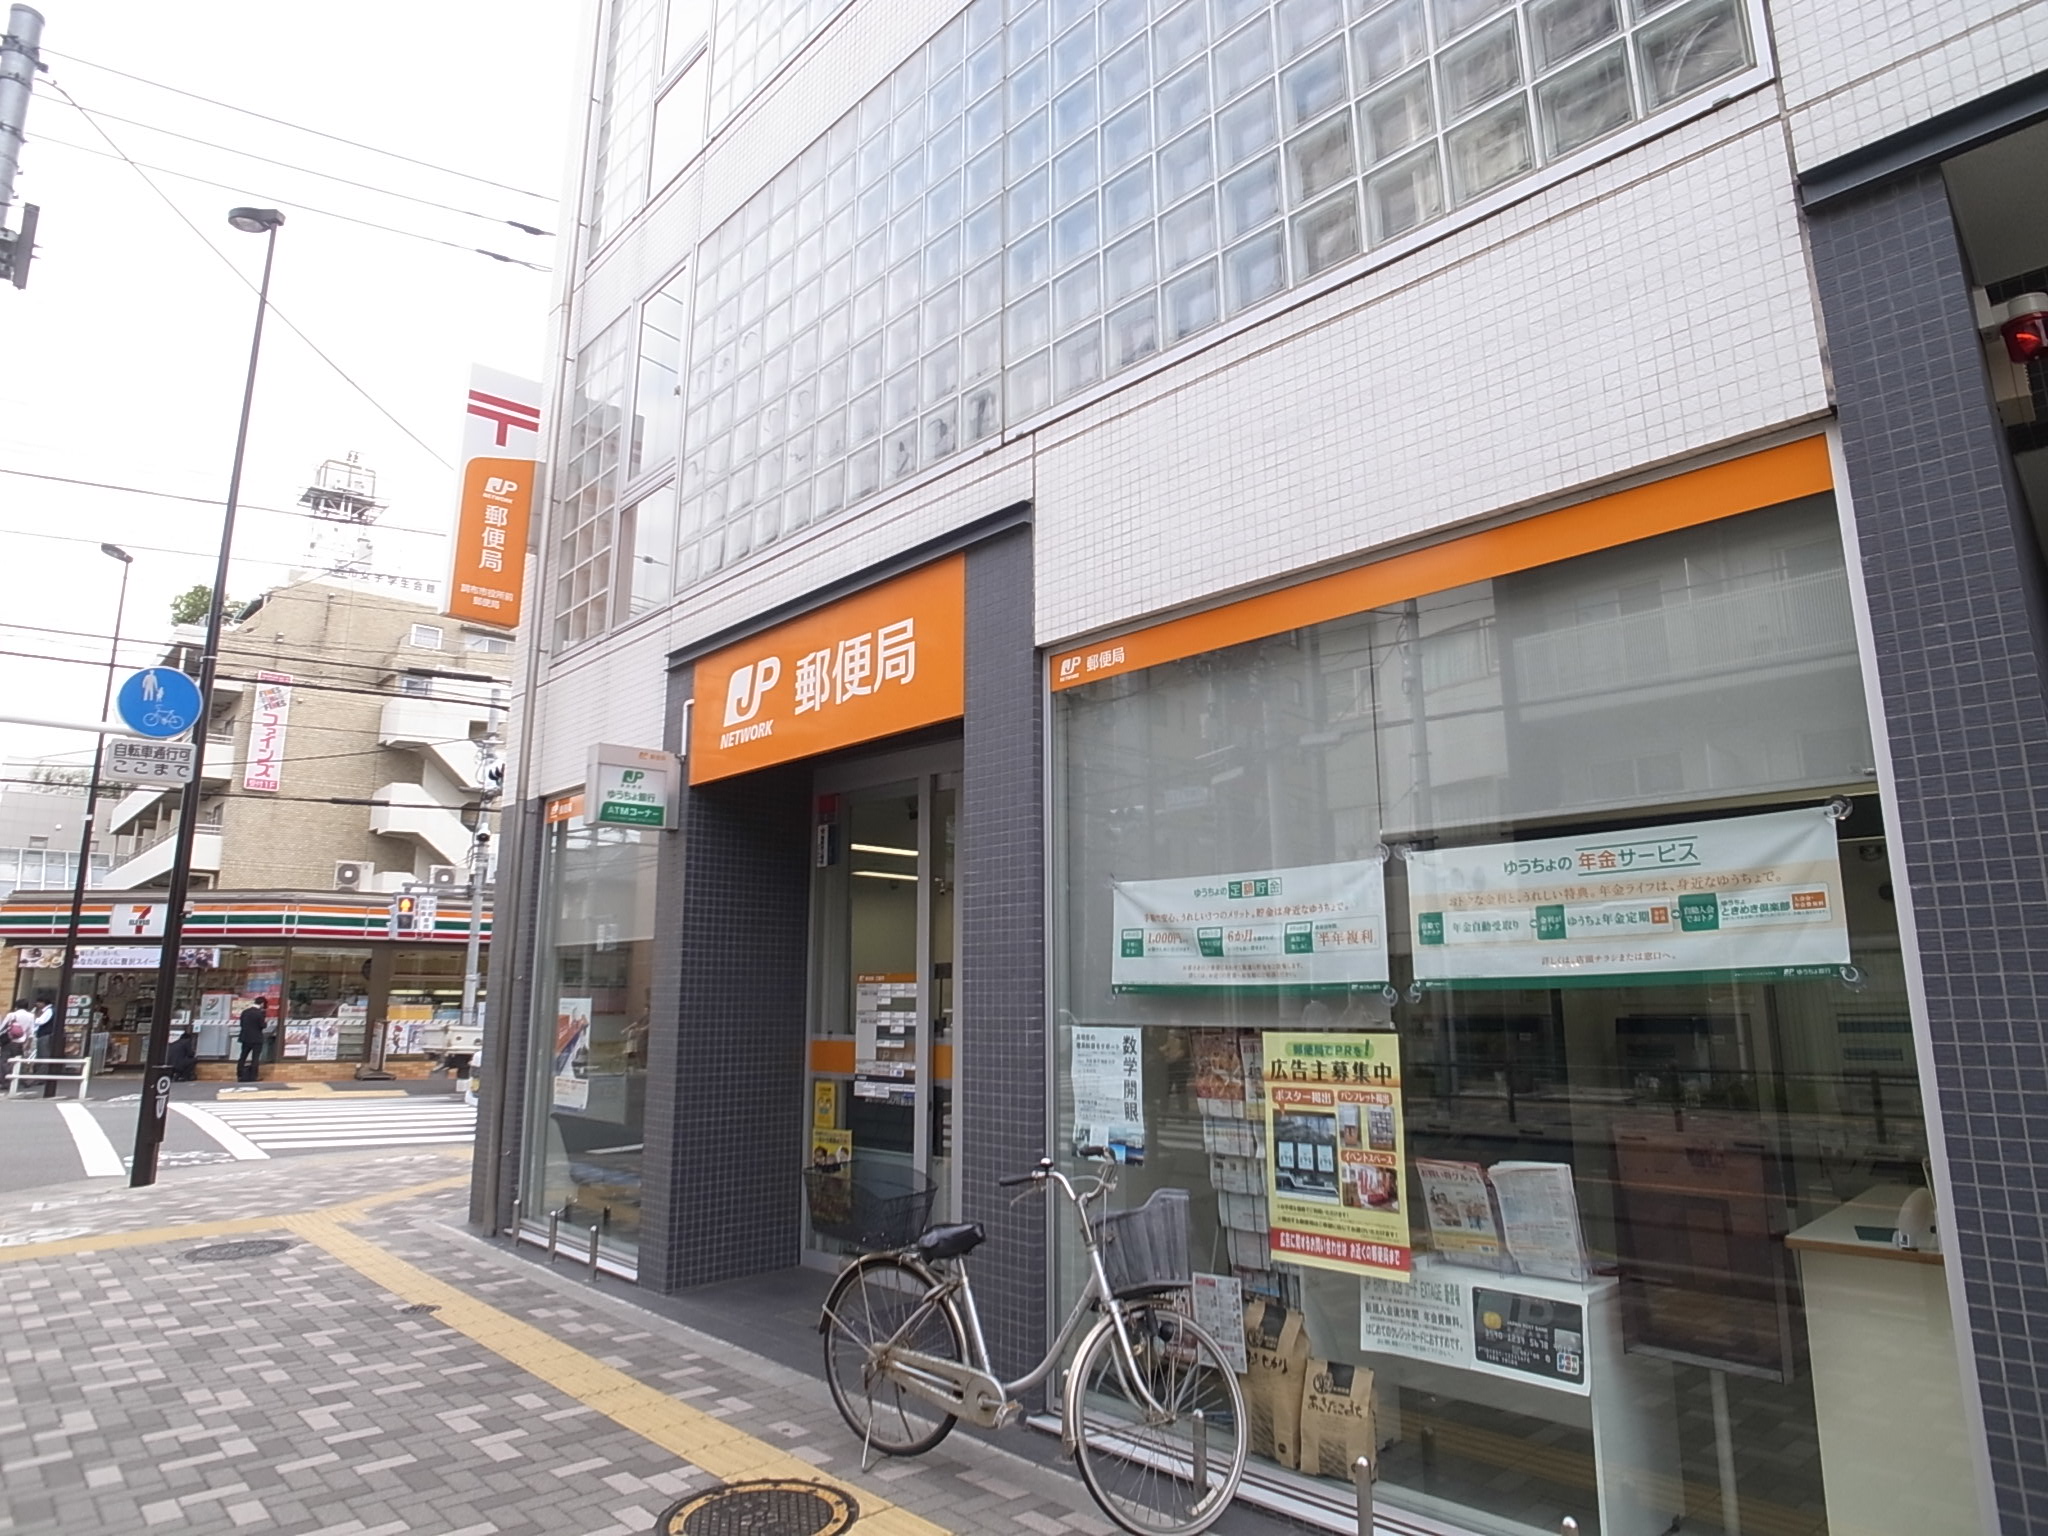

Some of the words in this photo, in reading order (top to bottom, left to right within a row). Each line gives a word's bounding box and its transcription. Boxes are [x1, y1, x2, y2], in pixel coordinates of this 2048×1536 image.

[484, 477, 518, 496] JP
[479, 504, 509, 573] 郵便局
[1060, 656, 1081, 677] JP
[1086, 646, 1125, 672] 郵便局
[724, 655, 781, 728] JP
[794, 617, 916, 717] 郵便局
[719, 719, 775, 750] NETWORK
[113, 743, 192, 761] 自転車通行可
[113, 760, 190, 778] ここまで
[622, 770, 645, 784] JP
[607, 789, 656, 804] ゆうちょ銀行
[607, 806, 661, 818] ATMコーナー
[1503, 854, 1573, 876] ゆうちょの
[1578, 841, 1699, 871] 年金サービス
[1684, 904, 1714, 915] 自動入会
[1721, 902, 1790, 916] ときめき倶楽部
[132, 905, 152, 934] 7
[1452, 920, 1520, 934] 年金自動受取り
[1567, 910, 1650, 928] ゆうちょ年金定期
[1684, 914, 1714, 924] でおトク
[1122, 1035, 1139, 1122] 数学開眼
[1270, 1059, 1392, 1085] 広告主募集中
[1275, 1090, 1332, 1104] ポスター掲出
[1340, 1092, 1390, 1104] パンフレット掲出
[1343, 1152, 1393, 1164] イベントスペース
[1280, 1232, 1347, 1257] 広告に関するお問い合わせは
[1350, 1243, 1400, 1266] お近くの郵便局まで
[1529, 1337, 1549, 1350] 5678
